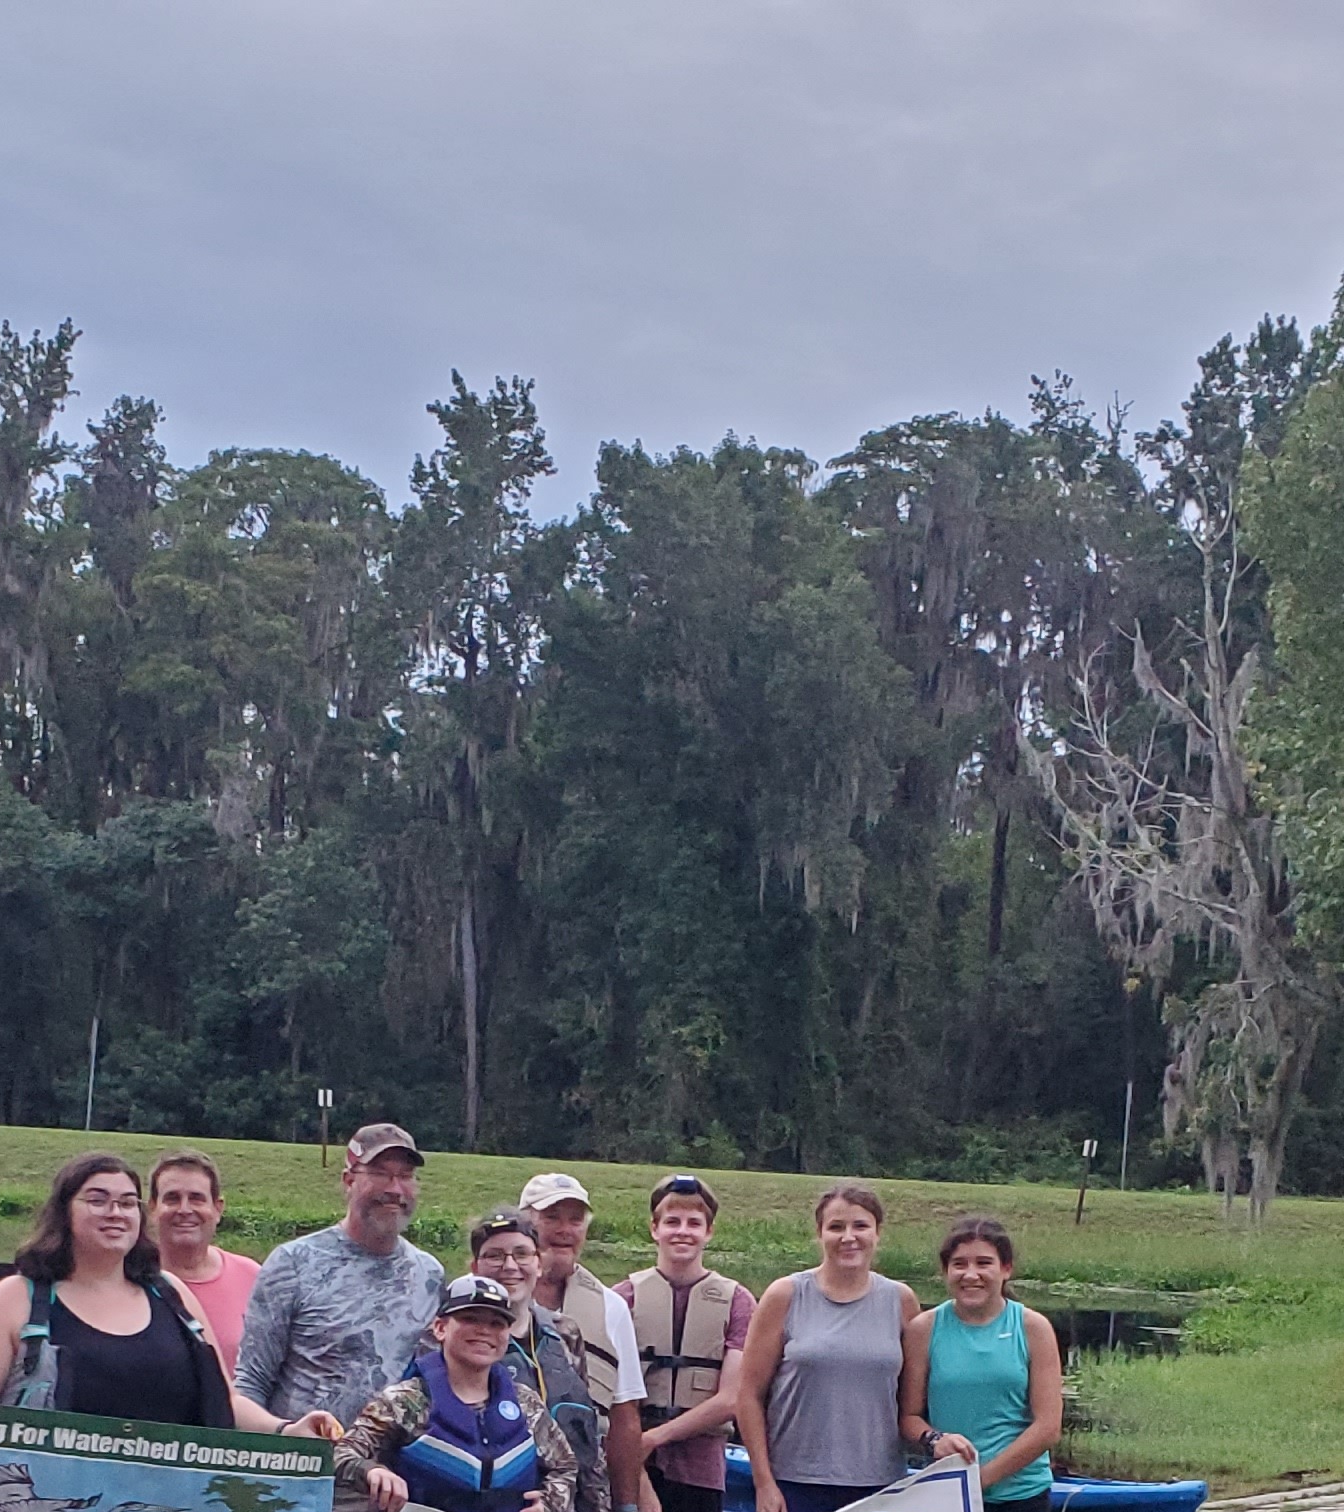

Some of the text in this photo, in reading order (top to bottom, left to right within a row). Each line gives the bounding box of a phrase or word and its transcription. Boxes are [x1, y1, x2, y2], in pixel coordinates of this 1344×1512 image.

[10, 1422, 50, 1445] For
[54, 1427, 179, 1461] Watershed
[183, 1442, 323, 1473] Conservation
